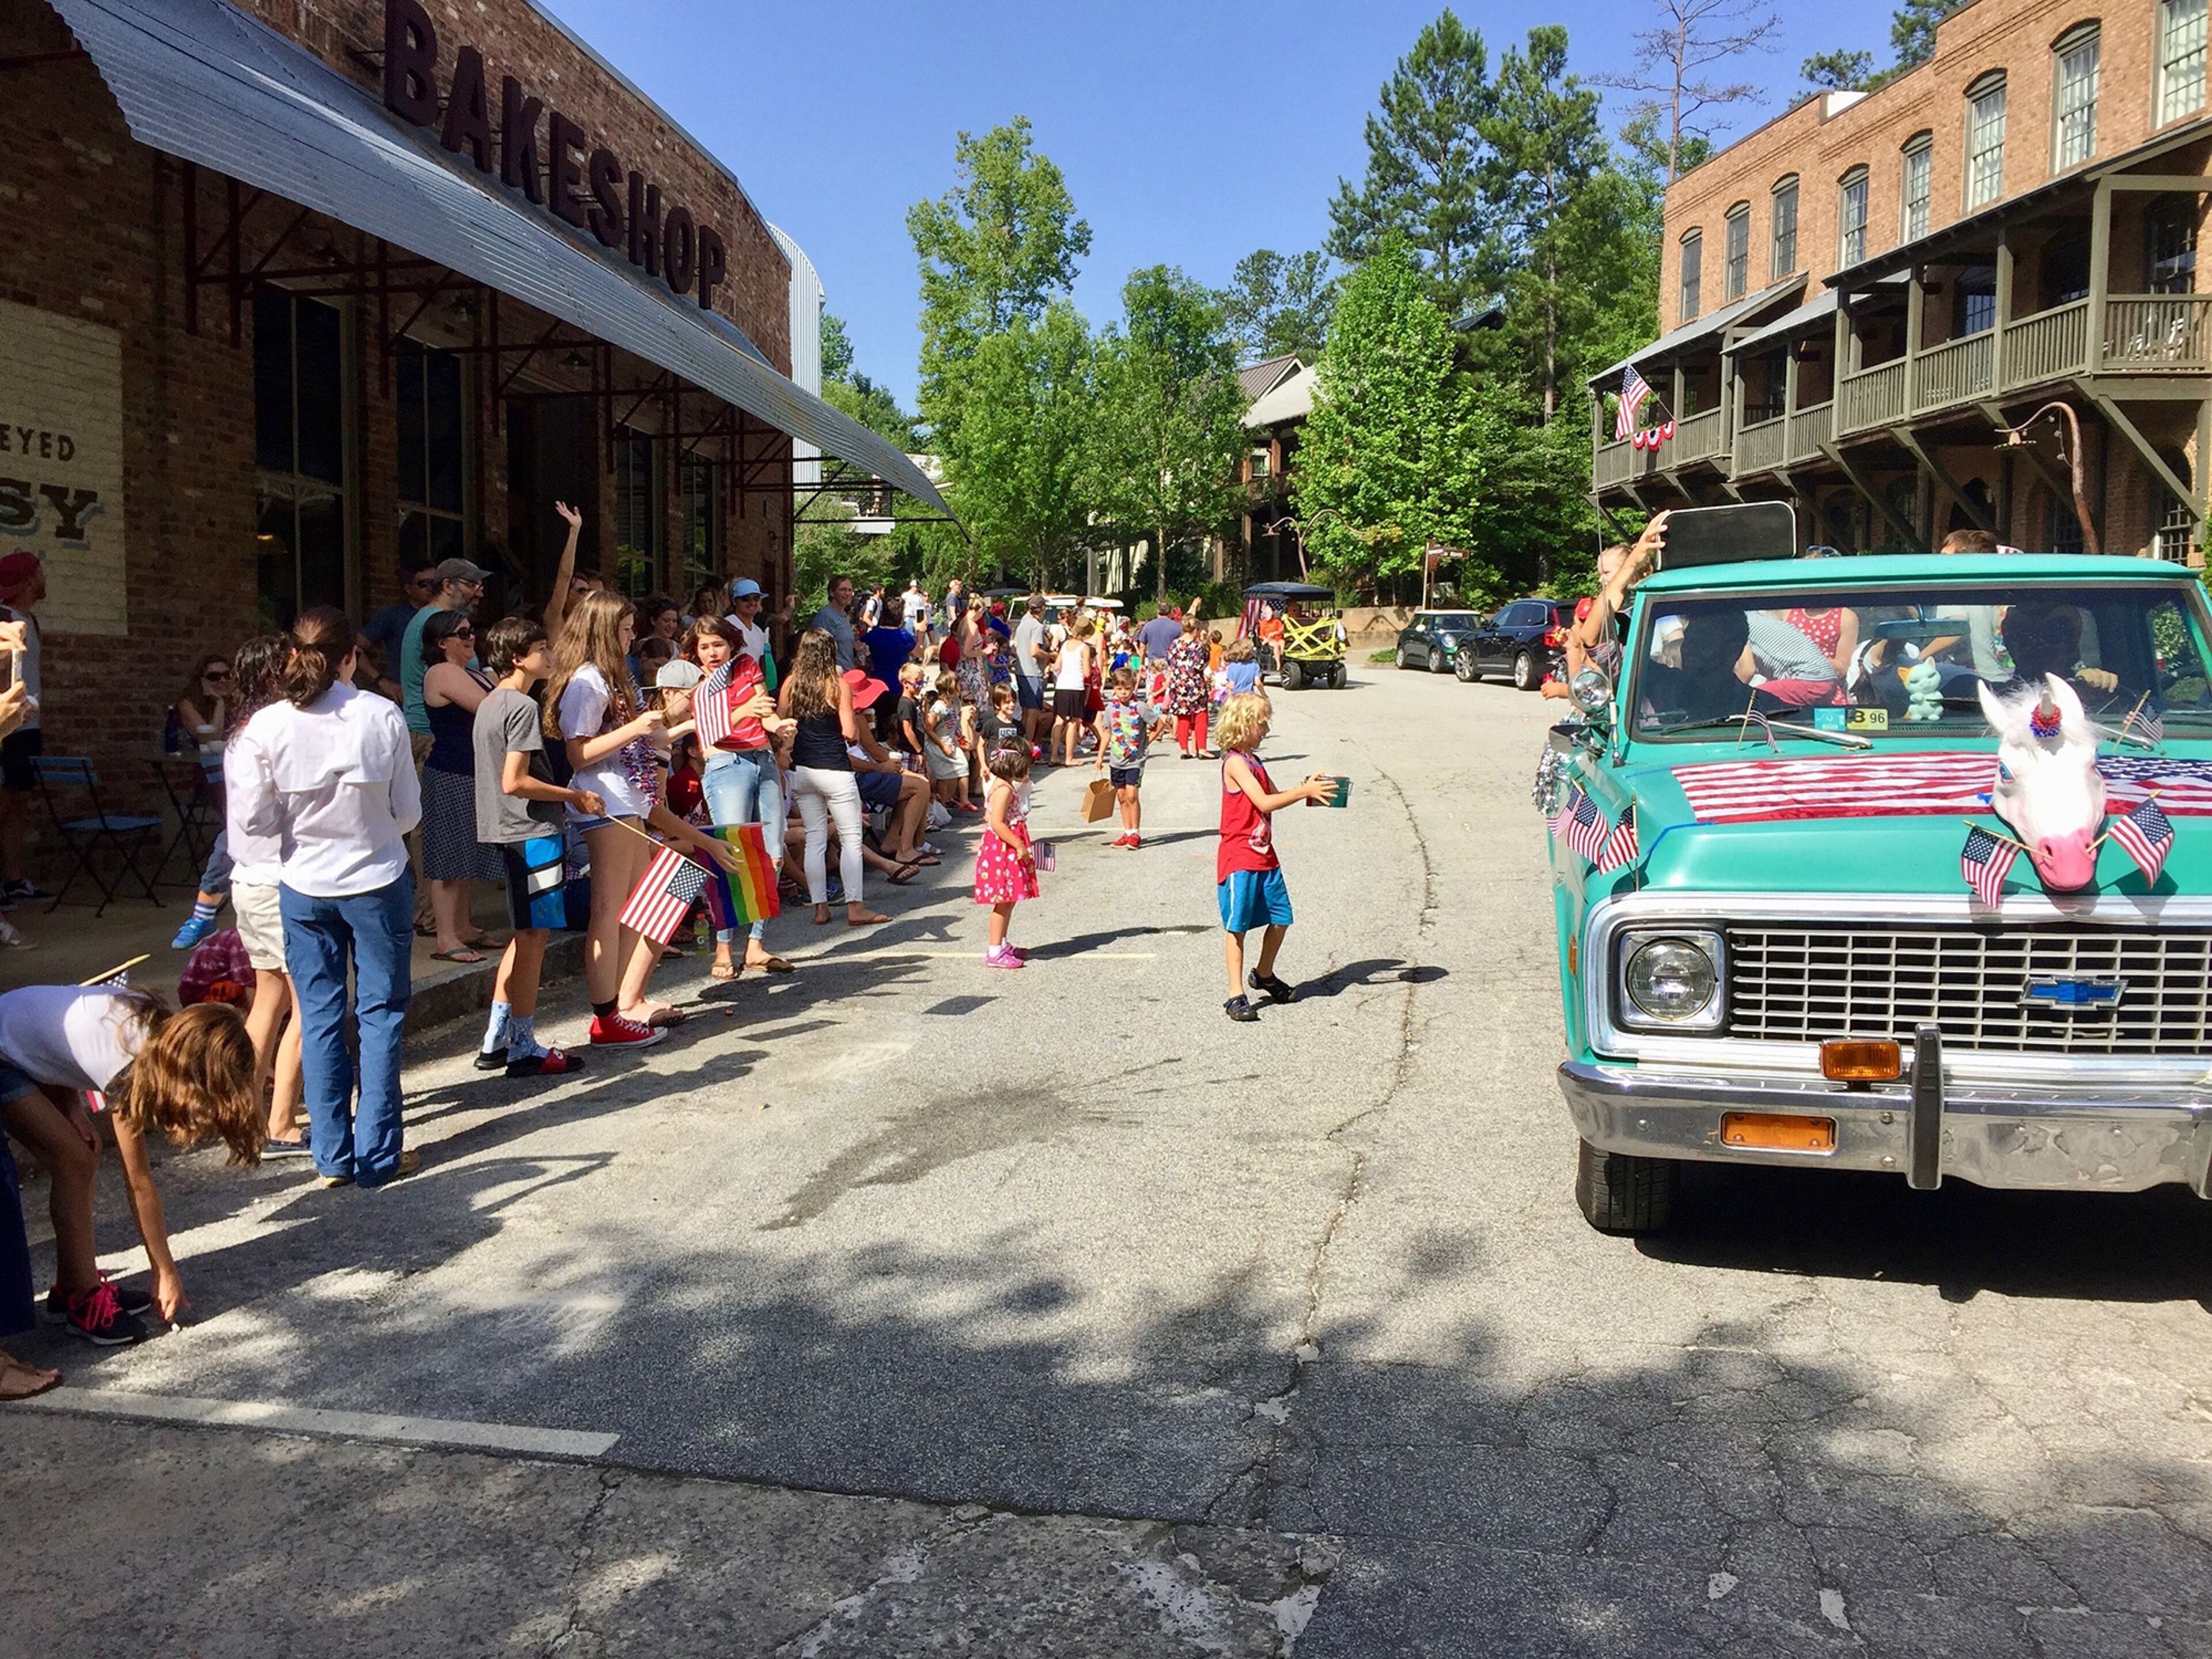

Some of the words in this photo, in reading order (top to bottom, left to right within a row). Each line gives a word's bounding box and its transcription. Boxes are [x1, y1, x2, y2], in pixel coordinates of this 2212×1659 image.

[384, 0, 726, 310] BAKESHOP
[0, 423, 75, 461] EYED
[1869, 713, 1885, 724] 96
[697, 935, 704, 944] G
